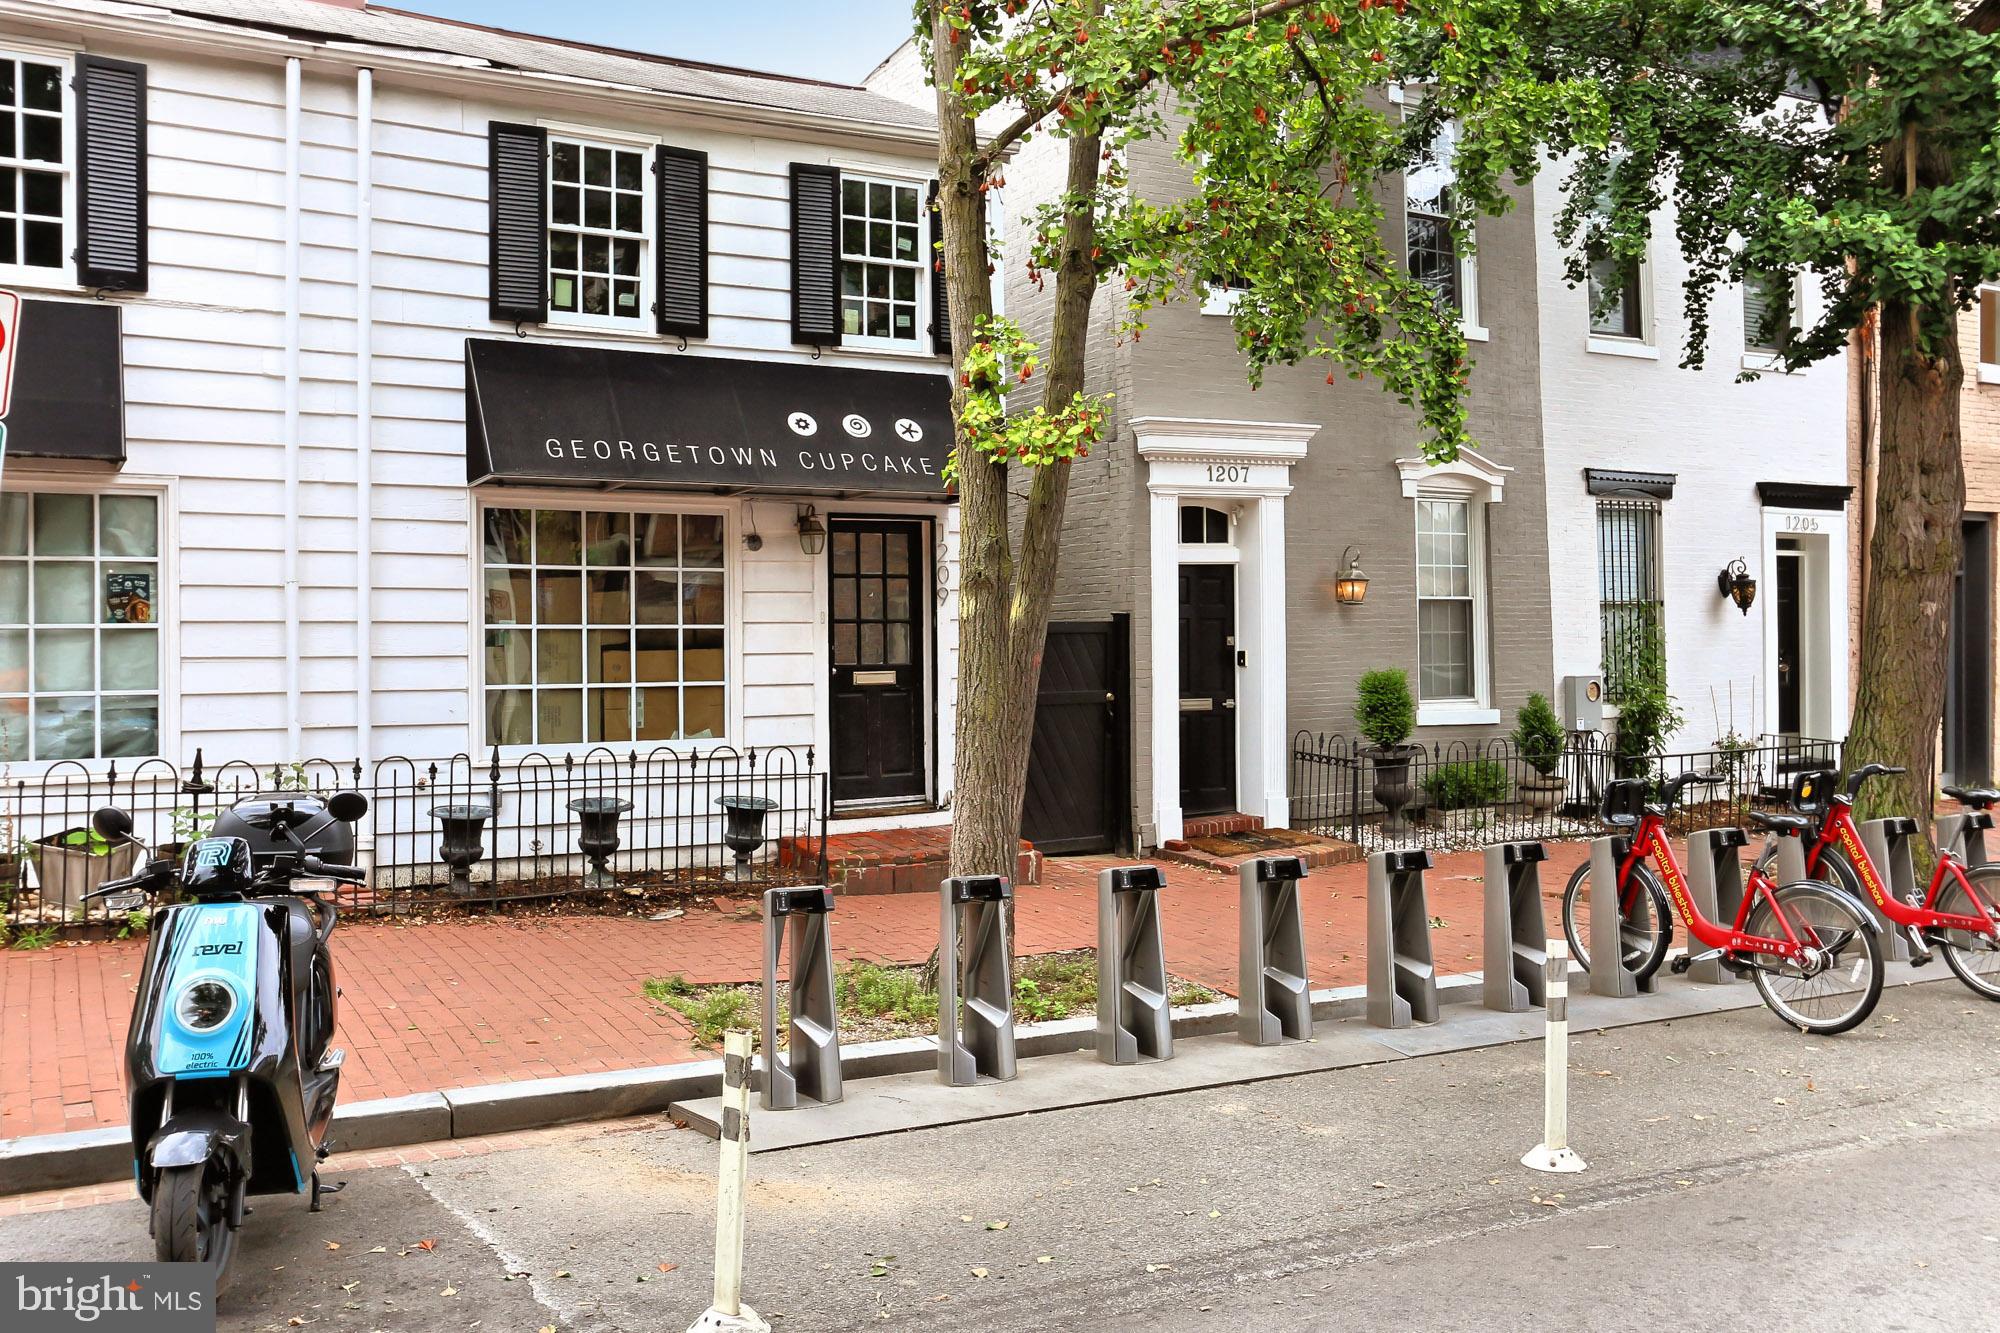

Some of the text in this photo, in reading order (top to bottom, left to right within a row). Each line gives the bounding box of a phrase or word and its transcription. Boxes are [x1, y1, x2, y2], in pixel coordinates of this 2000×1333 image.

[545, 438, 936, 477] GEORGETOWN CUPCAKE
[1207, 465, 1249, 483] 1207
[1786, 516, 1819, 531] 1205
[937, 523, 950, 606] 1209
[1839, 827, 1884, 906] capital bikeshare
[1652, 839, 1694, 926] capital bikeshare
[192, 941, 243, 957] revel
[185, 1061, 219, 1070] electric
[191, 1052, 214, 1061] 100%
